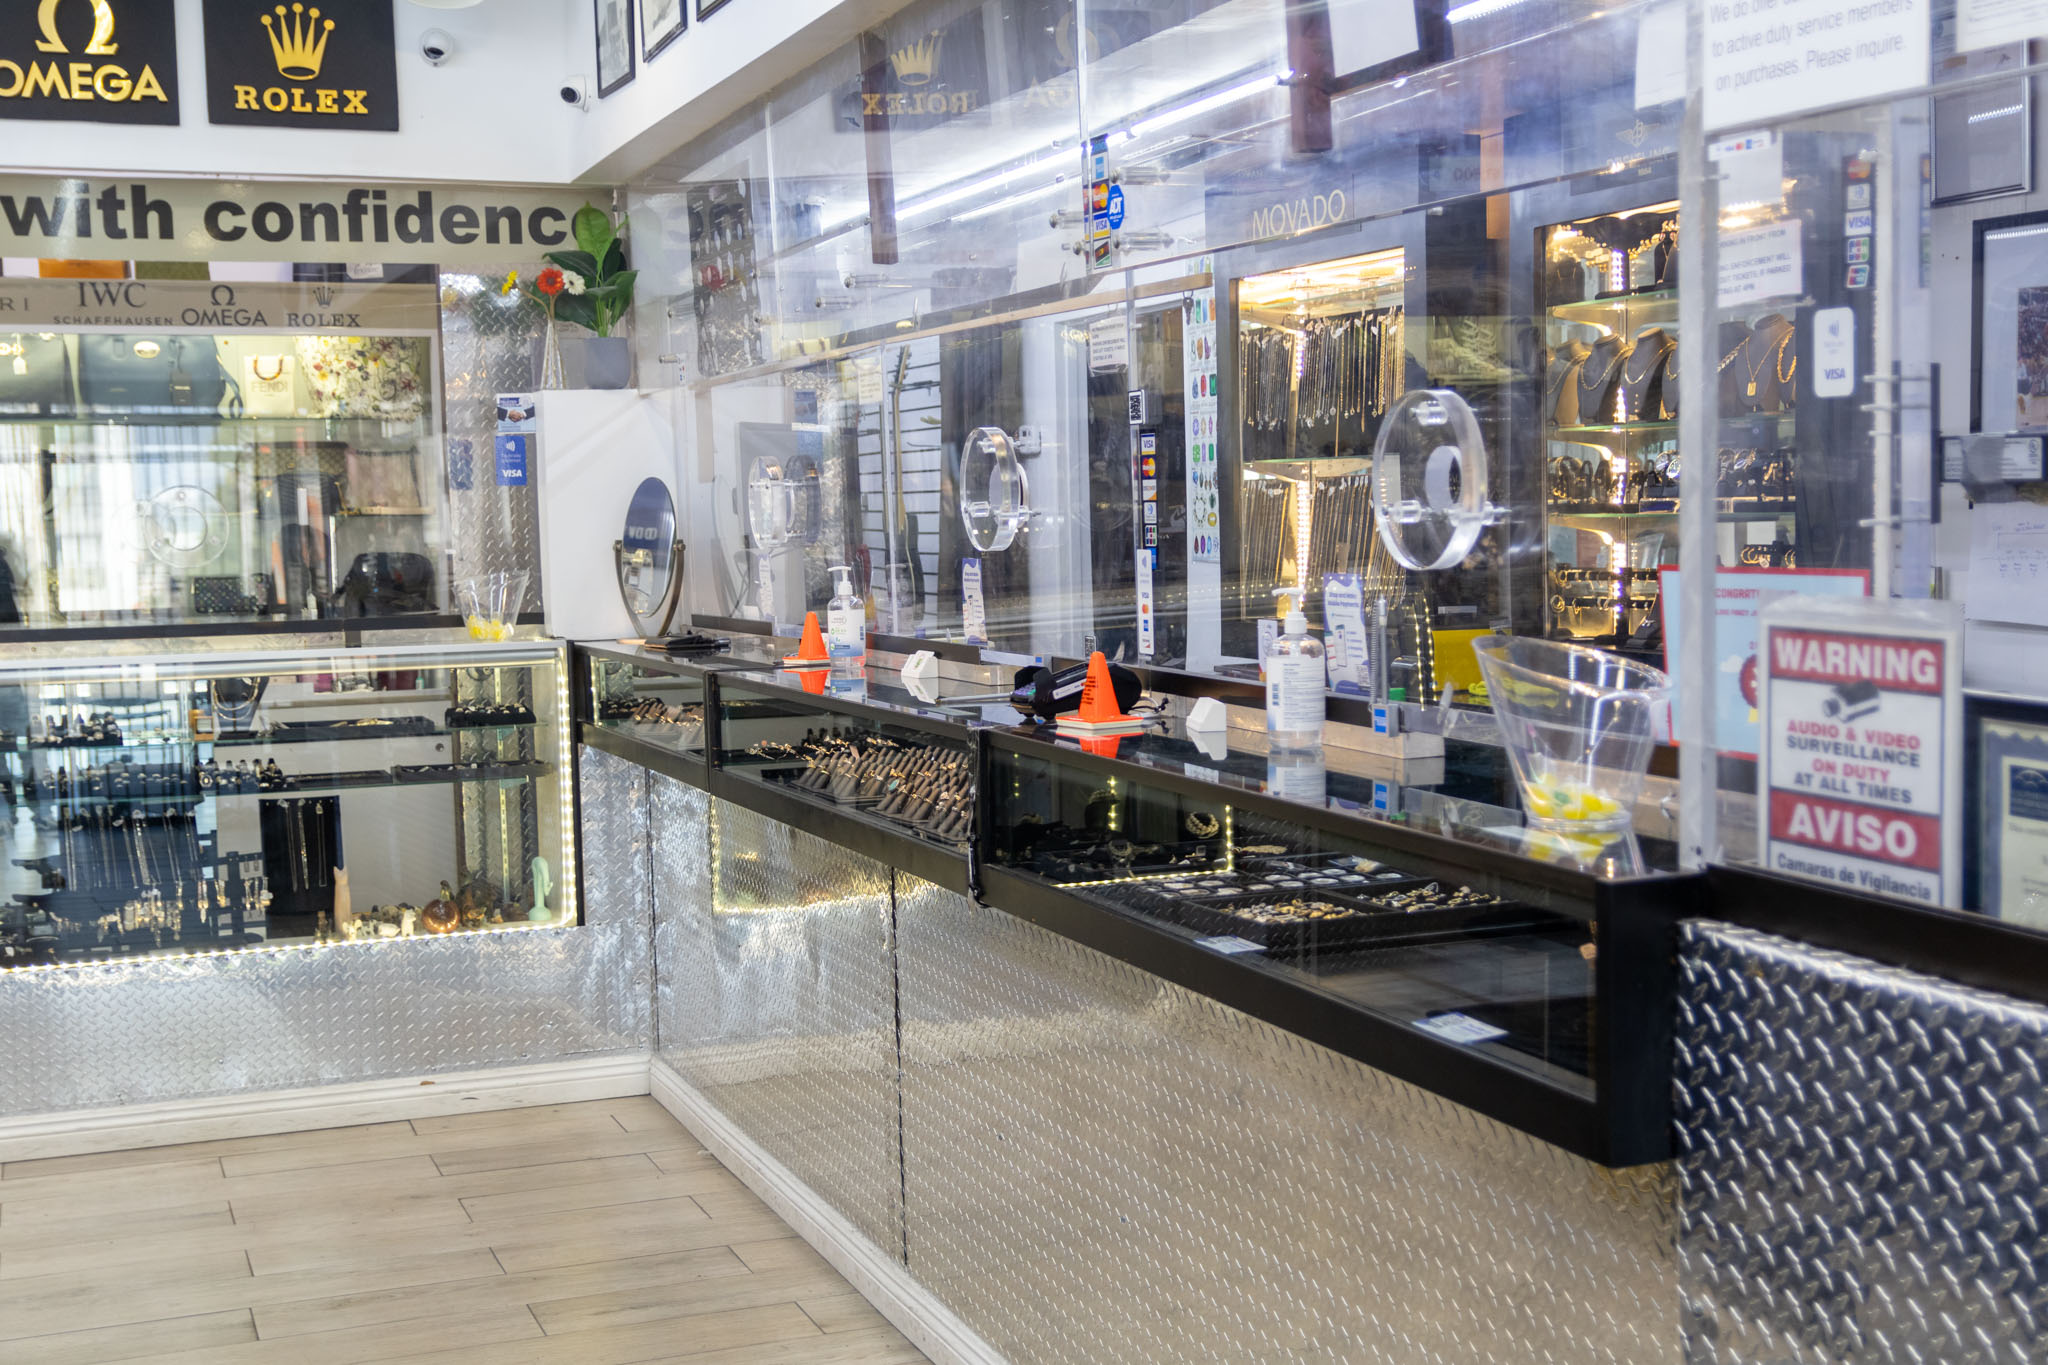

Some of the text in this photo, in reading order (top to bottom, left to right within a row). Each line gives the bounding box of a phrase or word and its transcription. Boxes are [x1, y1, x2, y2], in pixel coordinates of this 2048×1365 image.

[1710, 4, 1730, 24] We
[1733, 0, 1748, 18] do
[1712, 0, 1913, 58] to active duty service members
[0, 59, 169, 103] OMEGA
[1716, 74, 1731, 92] on
[1806, 46, 1852, 70] Please
[234, 85, 369, 115] ROLEX
[0, 184, 579, 246] with confidenc
[1109, 197, 1122, 215] ADT
[1252, 189, 1346, 240] MOVADO
[1849, 215, 1872, 229] VISA
[78, 281, 147, 308] IWC
[53, 315, 173, 326] SCHAFFHAUSEN
[181, 307, 268, 327] OMEGA
[287, 312, 361, 328] ROLEX
[1823, 367, 1846, 380] VISA
[502, 468, 523, 478] VISA
[1774, 636, 1937, 686] WARNING
[1787, 719, 1921, 751] AUDIO & VIDEO
[1786, 735, 1921, 769] SURVEILLANCE
[1812, 758, 1891, 783] ON DUTY
[1794, 772, 1913, 804] AT ALL TIMES
[1788, 802, 1918, 859] AVISO
[1776, 852, 1932, 900] Camaras de Vigilancia
